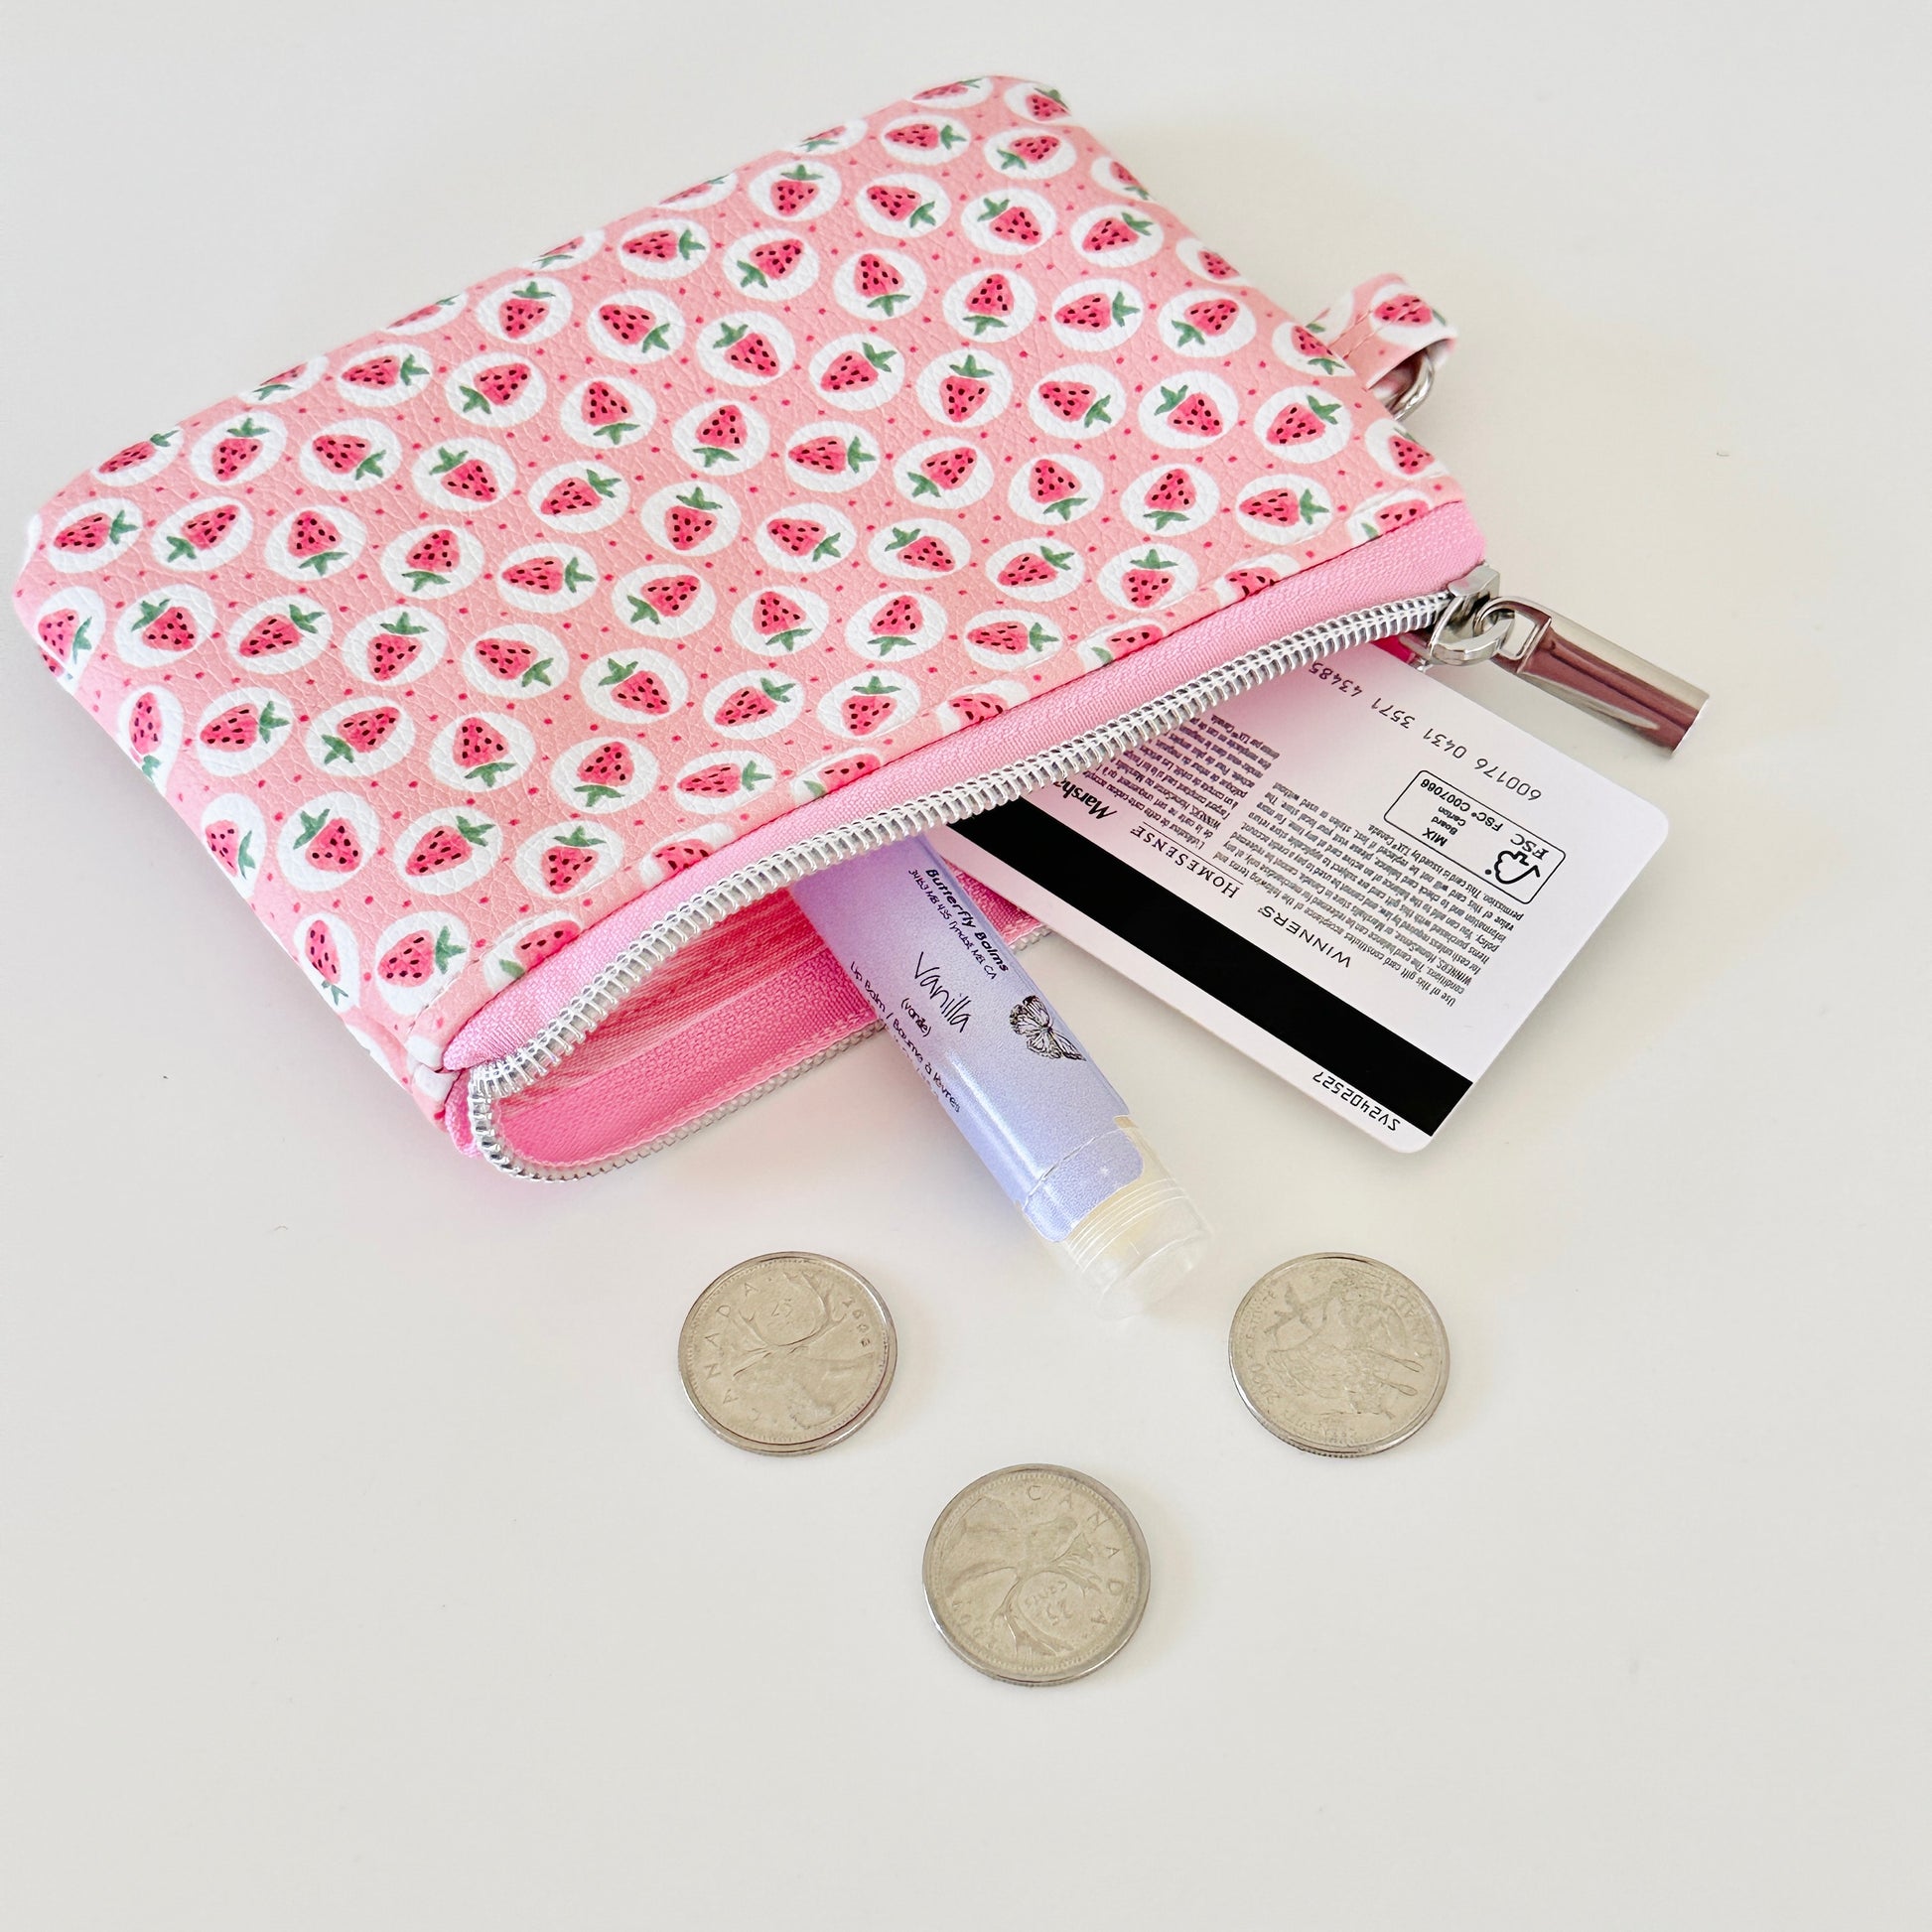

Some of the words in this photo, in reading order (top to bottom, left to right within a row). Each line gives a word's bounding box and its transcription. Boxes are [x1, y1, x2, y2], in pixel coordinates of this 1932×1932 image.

[1370, 697, 1415, 728] 3571
[1423, 728, 1466, 759] 0431
[1474, 758, 1541, 800] 600176
[1422, 827, 1448, 846] MIX
[1431, 815, 1457, 835] Board
[1509, 833, 1549, 860] FSC
[926, 869, 976, 928] Butterfly
[975, 931, 1009, 972] Balms
[1260, 905, 1350, 967] WINNERS
[914, 951, 972, 1033] Vanilla
[1311, 1071, 1400, 1131] SV2402527
[1027, 1485, 1125, 1625] CANADA
